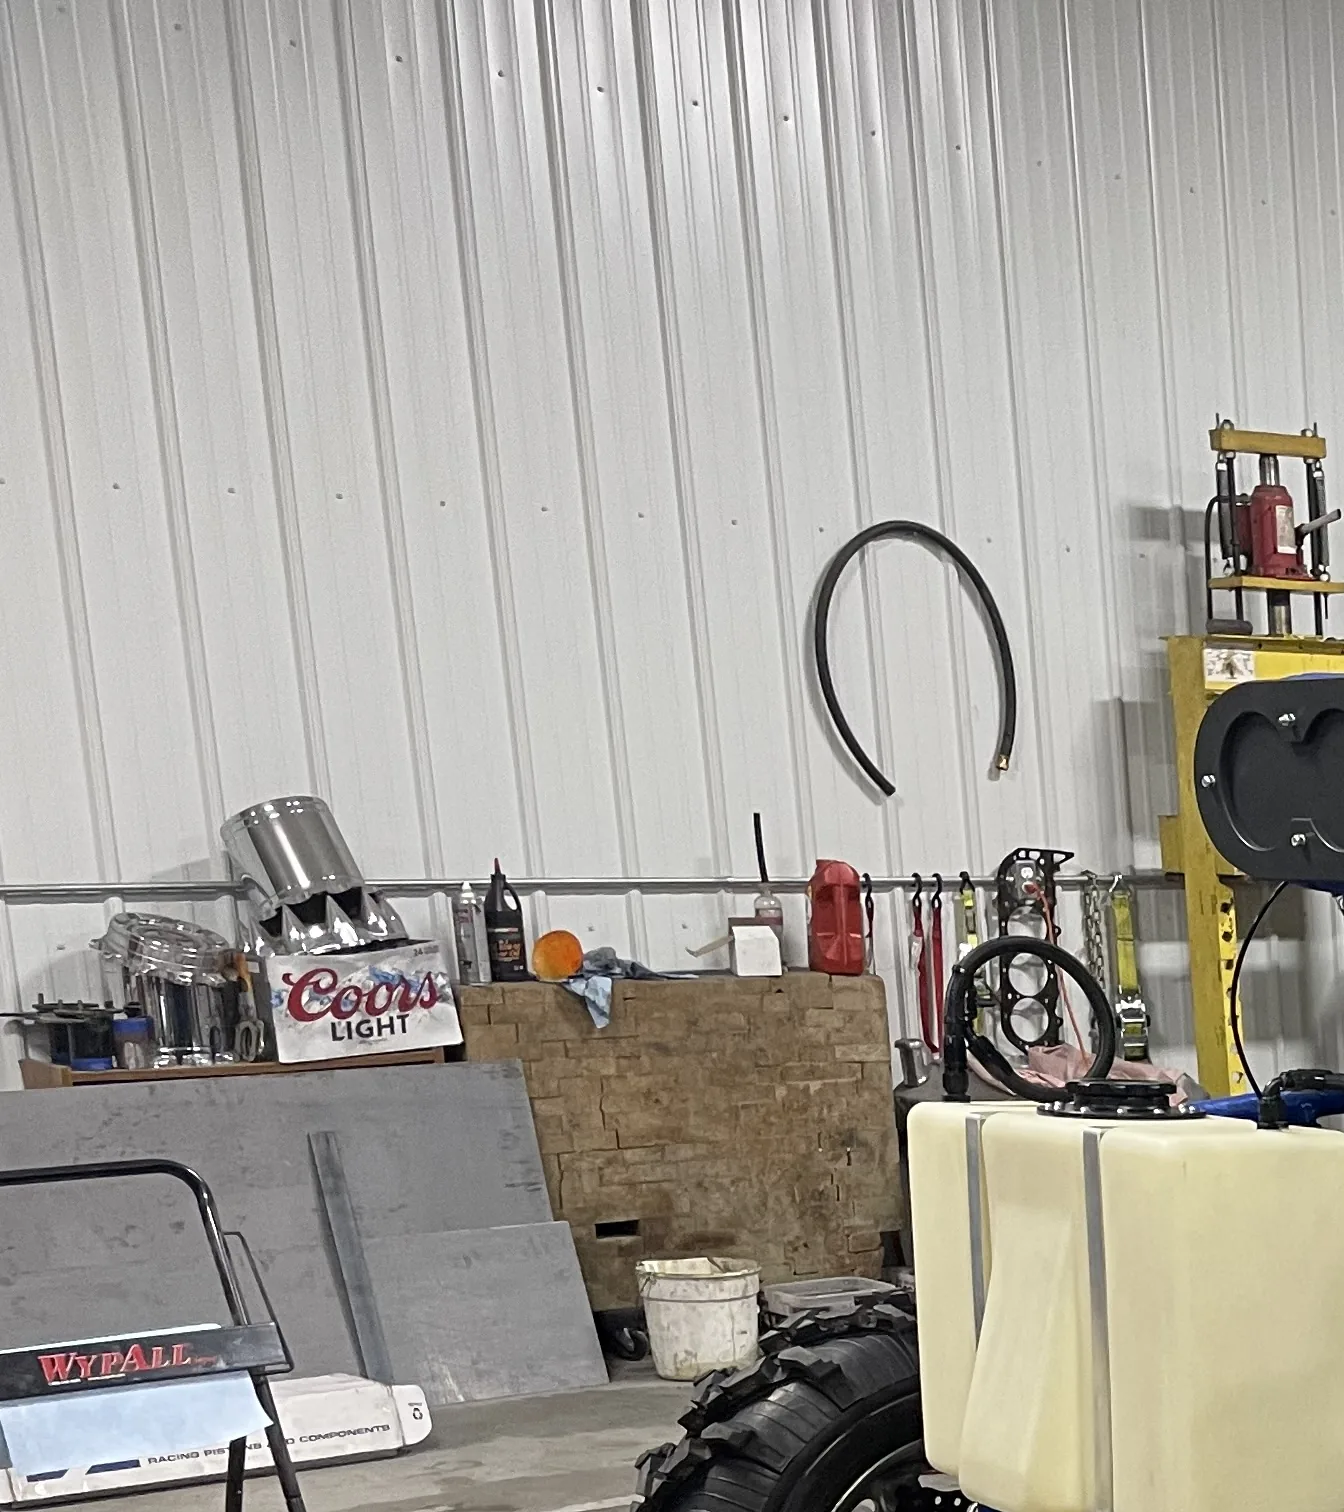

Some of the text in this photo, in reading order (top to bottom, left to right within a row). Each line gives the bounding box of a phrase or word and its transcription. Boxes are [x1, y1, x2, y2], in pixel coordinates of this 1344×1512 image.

[282, 967, 441, 1022] Coors
[331, 1013, 410, 1042] LIGHT
[38, 1343, 192, 1384] WYPALL
[148, 1450, 200, 1465] RACING
[300, 1424, 390, 1443] COMPONENTS
